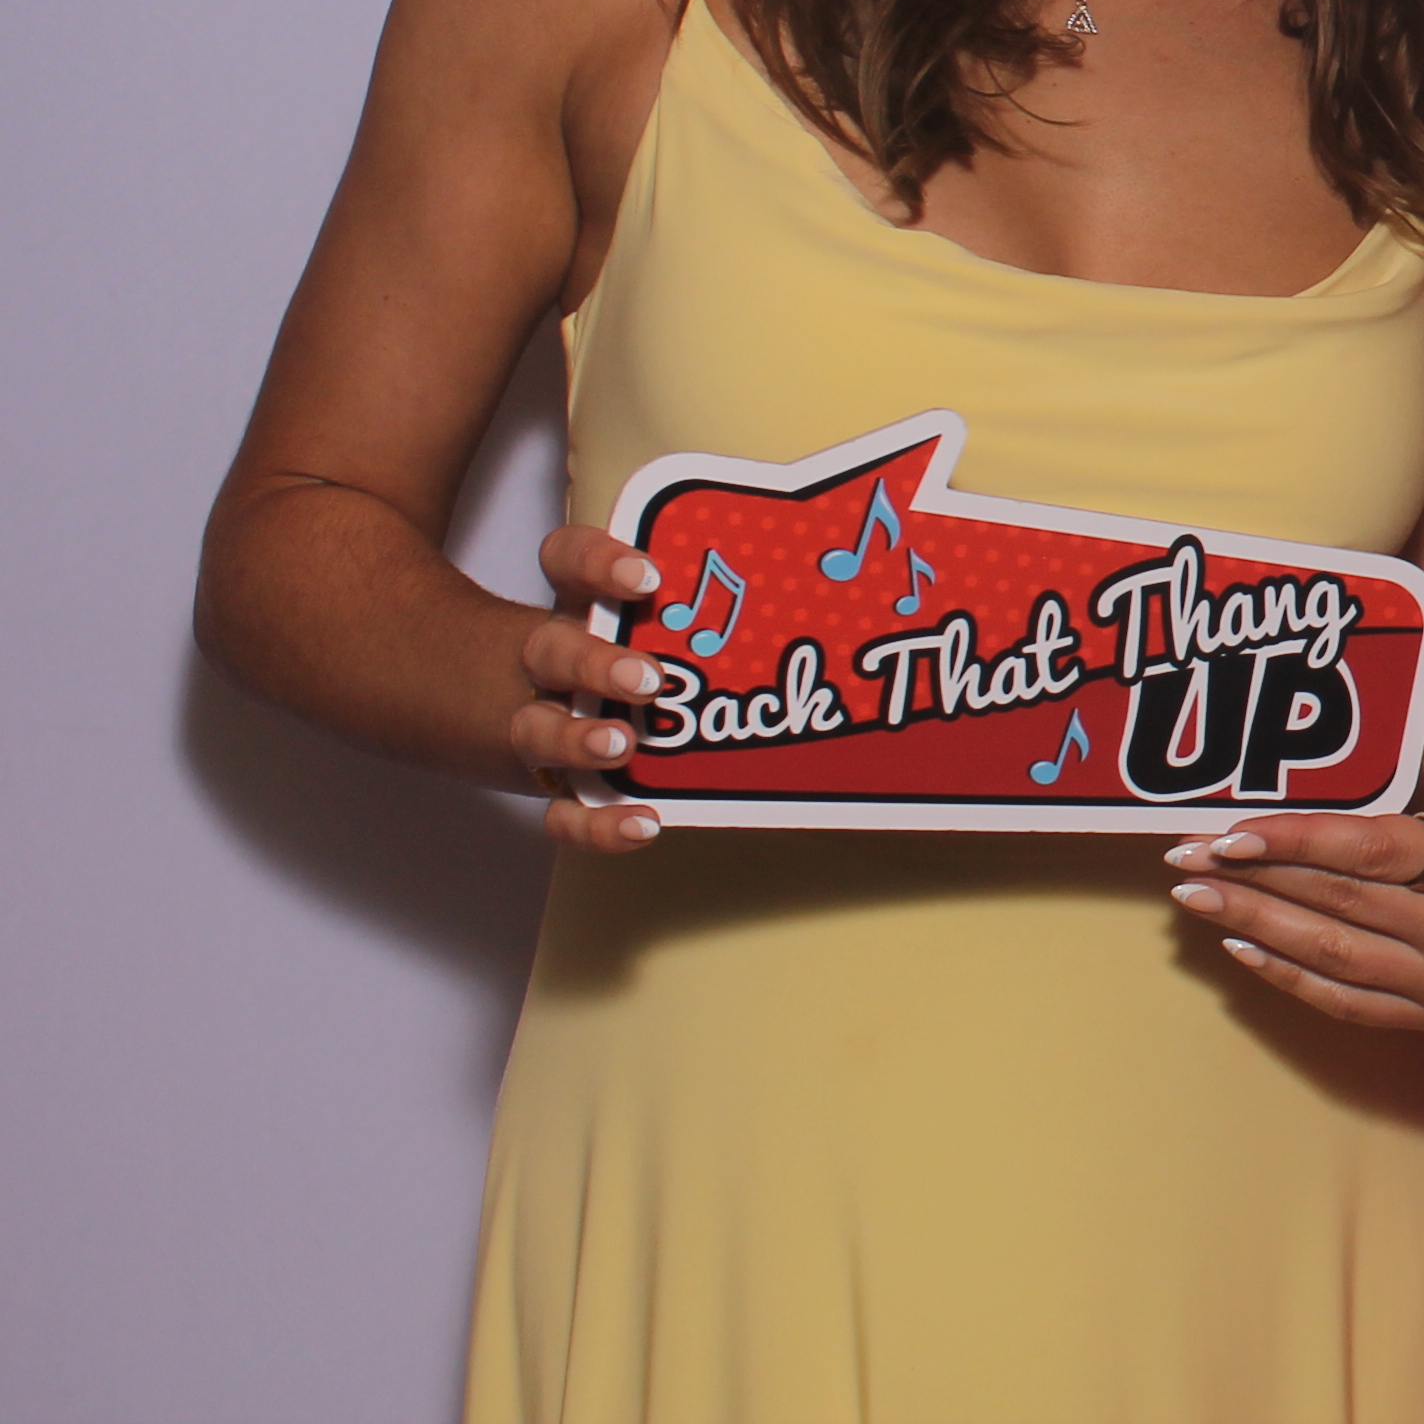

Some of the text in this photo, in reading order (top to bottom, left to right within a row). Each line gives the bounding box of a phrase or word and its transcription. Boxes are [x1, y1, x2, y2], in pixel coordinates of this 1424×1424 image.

[638, 544, 1358, 748] Back That Thang
[1118, 638, 1361, 803] UP
